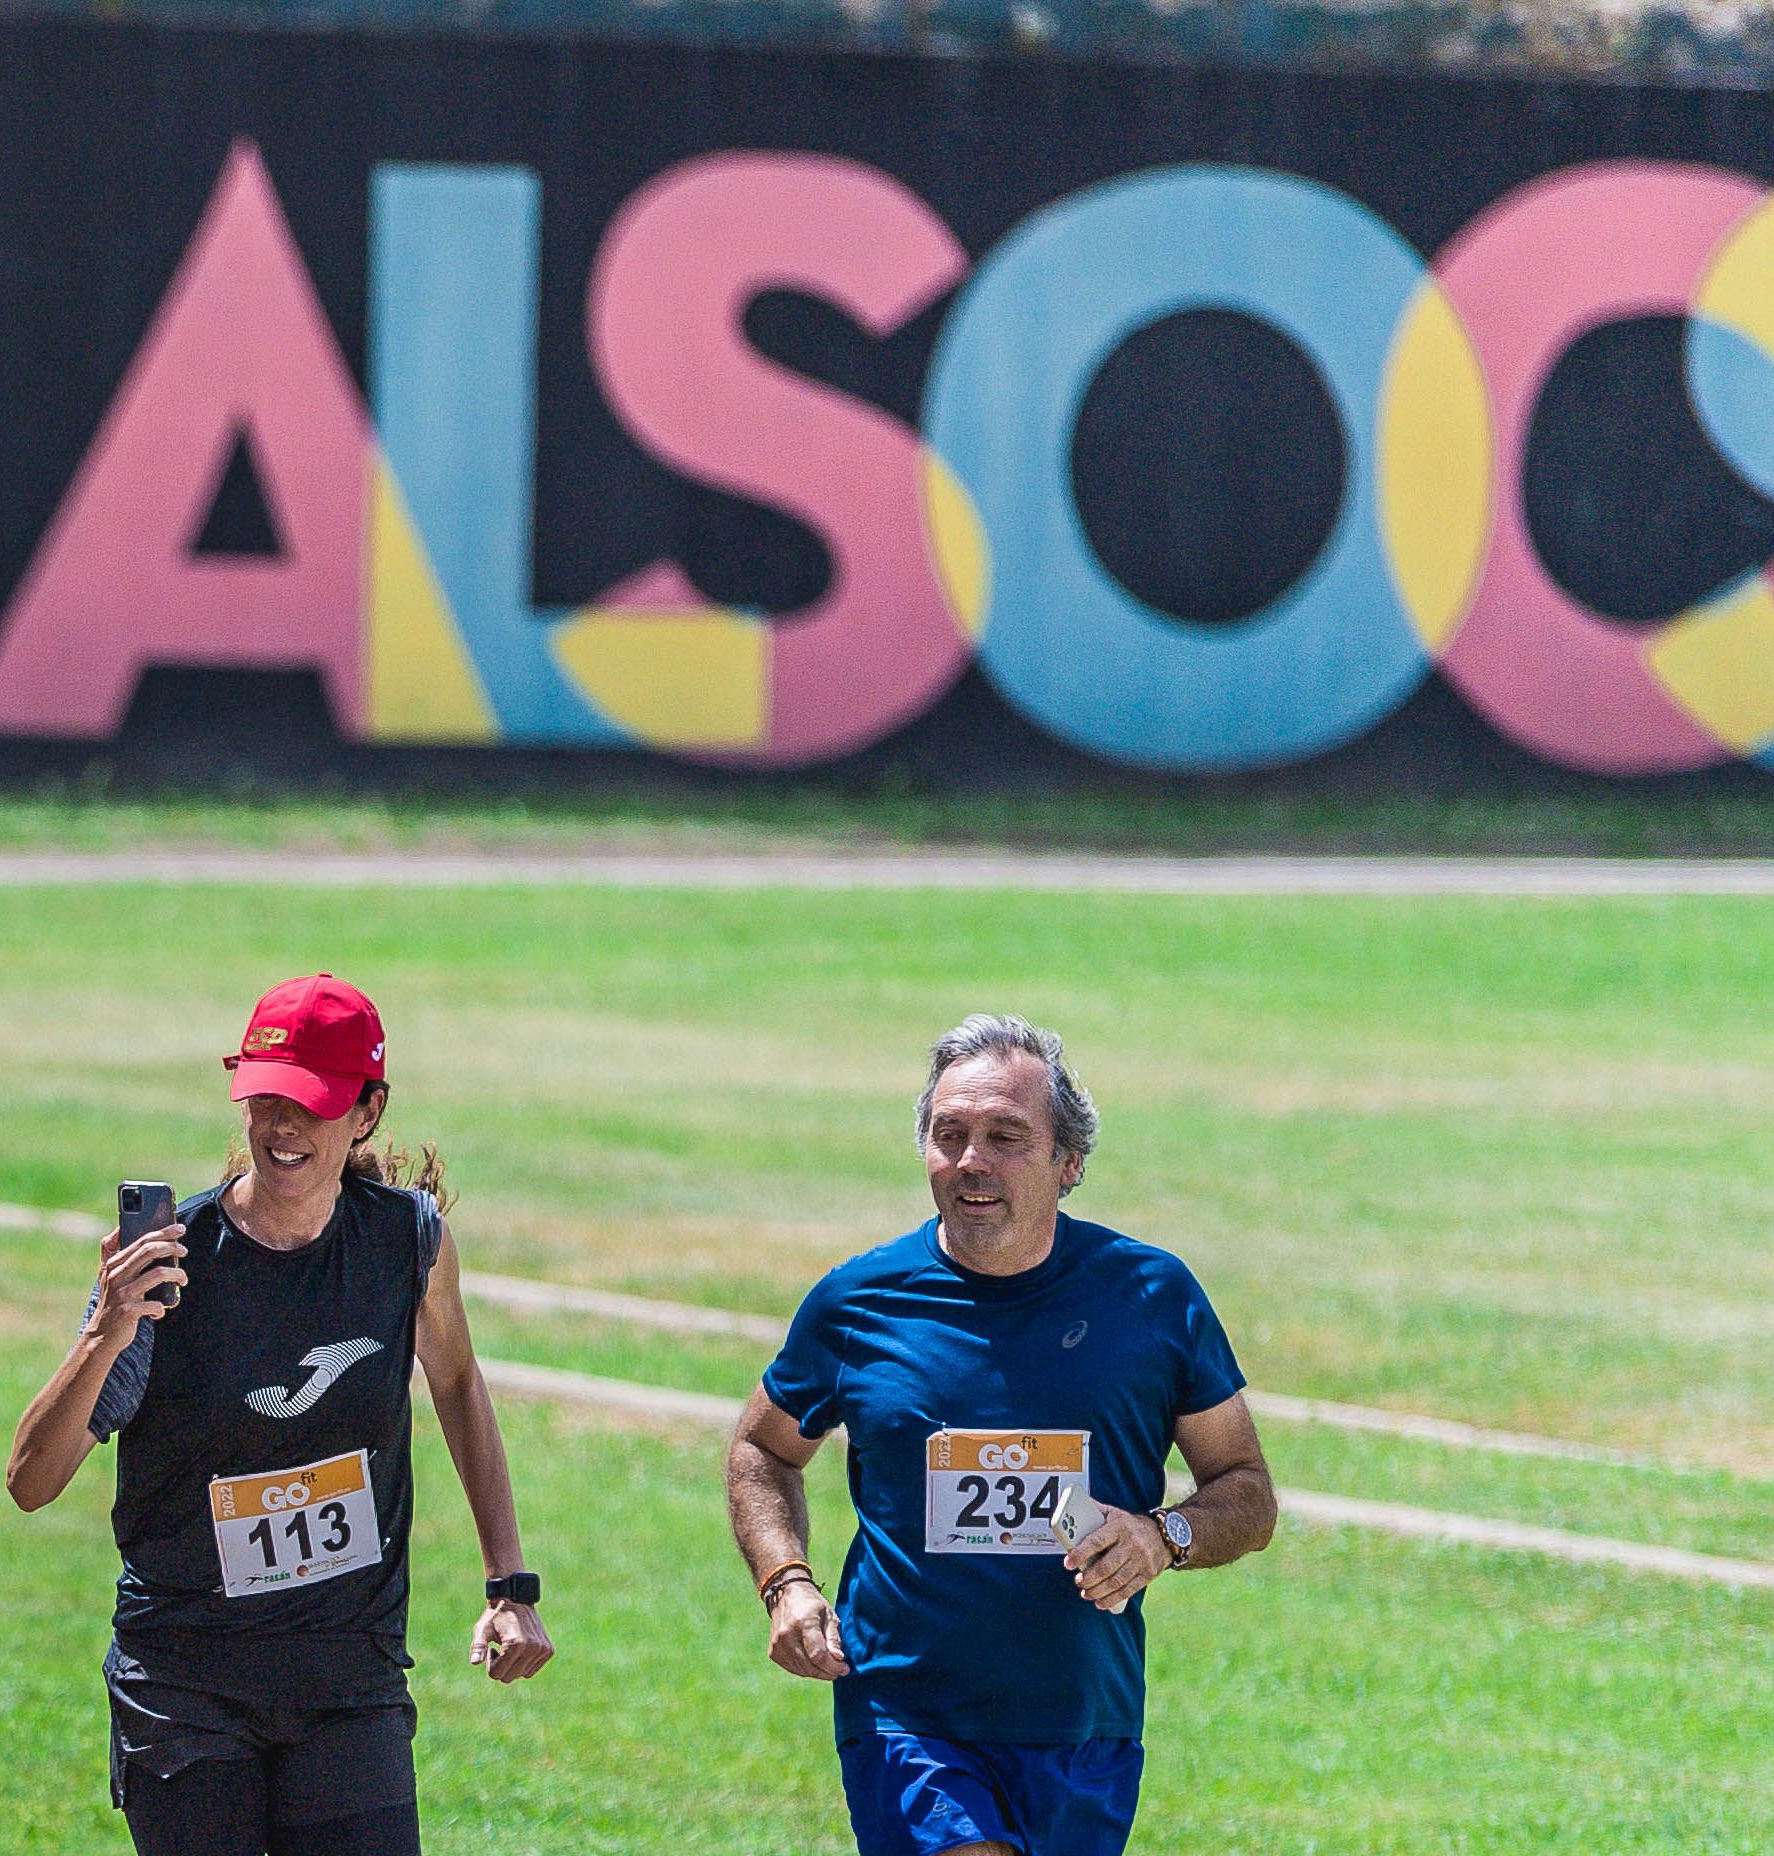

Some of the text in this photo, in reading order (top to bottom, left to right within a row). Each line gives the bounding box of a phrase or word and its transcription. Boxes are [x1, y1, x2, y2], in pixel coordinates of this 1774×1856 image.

[978, 1436, 1038, 1470] GO fit
[220, 1485, 236, 1517] 2022
[261, 1481, 311, 1511] GO
[300, 1471, 318, 1486] fit
[956, 1475, 1060, 1528] 234
[248, 1501, 352, 1568] 113
